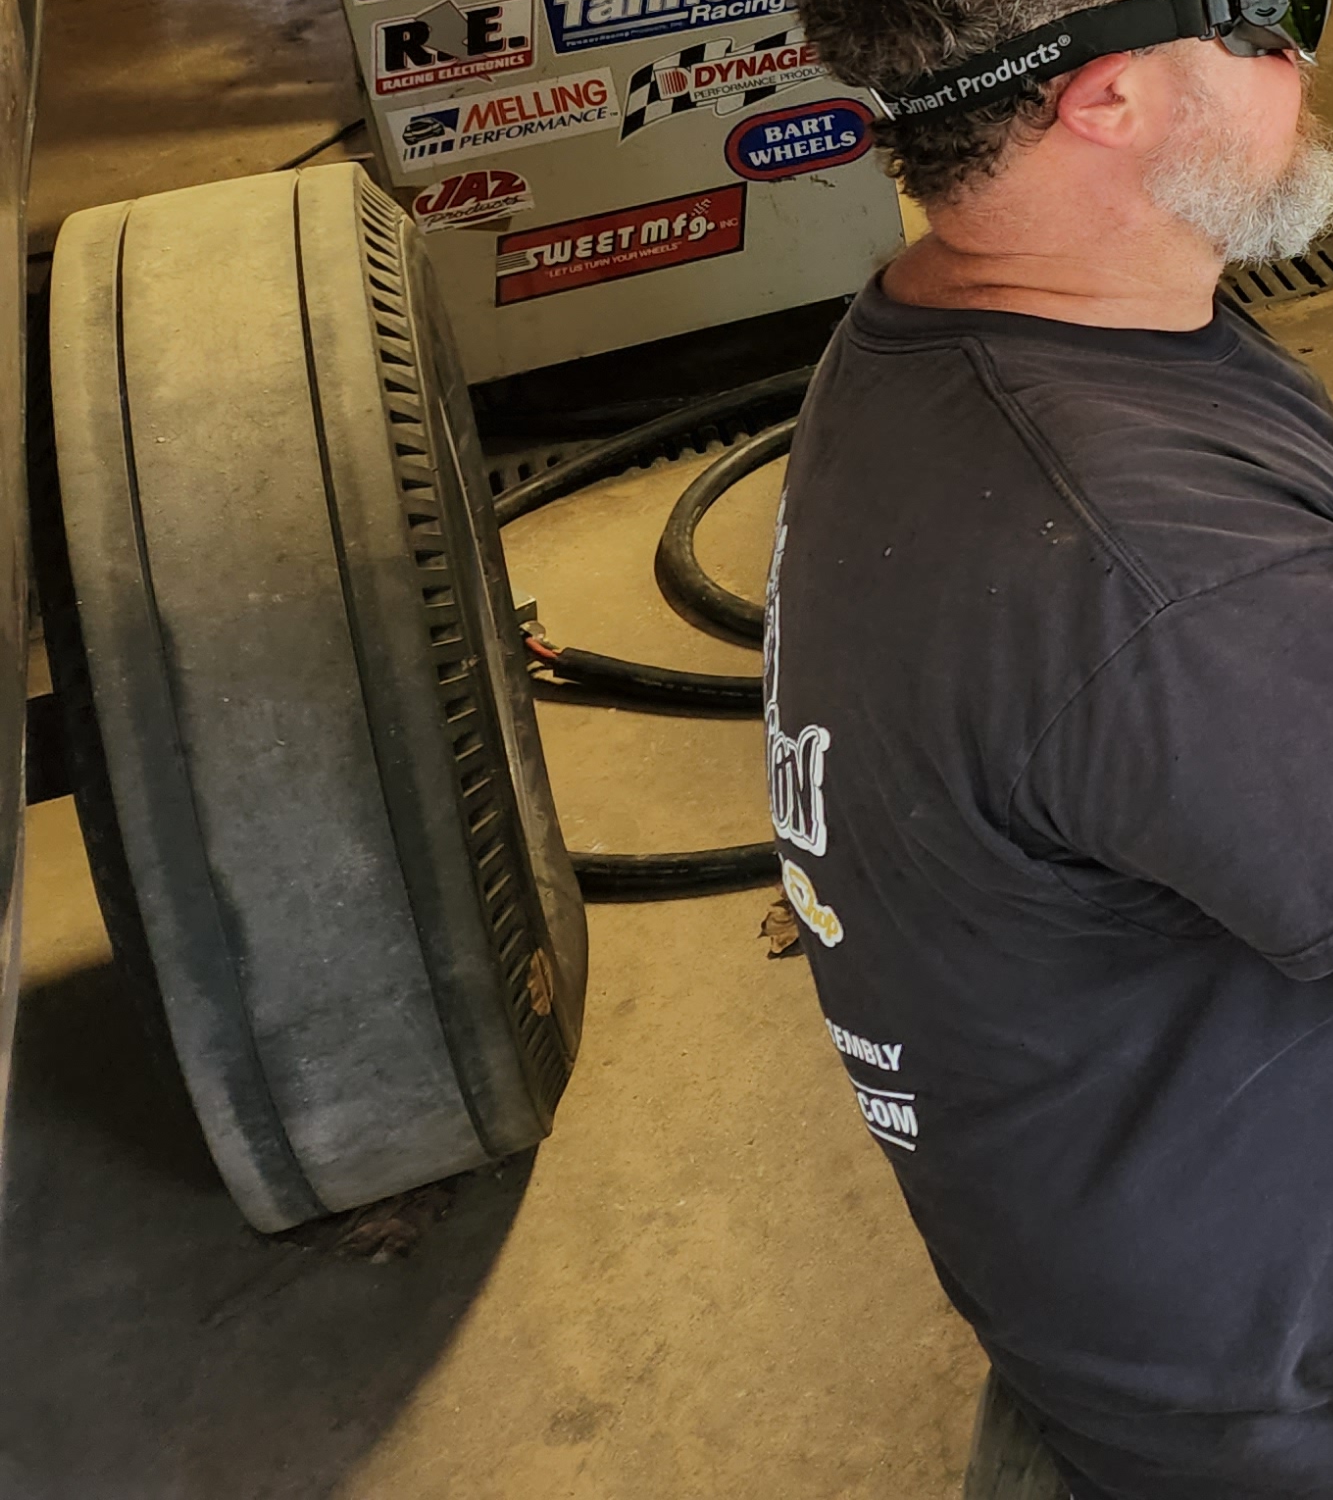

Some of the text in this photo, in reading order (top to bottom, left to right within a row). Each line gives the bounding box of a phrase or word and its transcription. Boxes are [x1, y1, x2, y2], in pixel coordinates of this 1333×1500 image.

[381, 54, 526, 92] RACING ELECTRONICS
[693, 65, 829, 101] PERFORMANCE PRODUC
[694, 42, 821, 89] DYNAGE
[462, 78, 608, 134] MELLING
[900, 85, 957, 115] Smart
[458, 105, 608, 150] PERFORMANCE
[763, 114, 836, 144] BART
[748, 129, 858, 167] WHEELS
[415, 169, 527, 215] JAZ
[522, 225, 636, 270] SWEET
[719, 216, 739, 231] INC
[569, 263, 583, 275] US
[583, 256, 611, 272] TURN
[611, 250, 639, 264] YOUR
